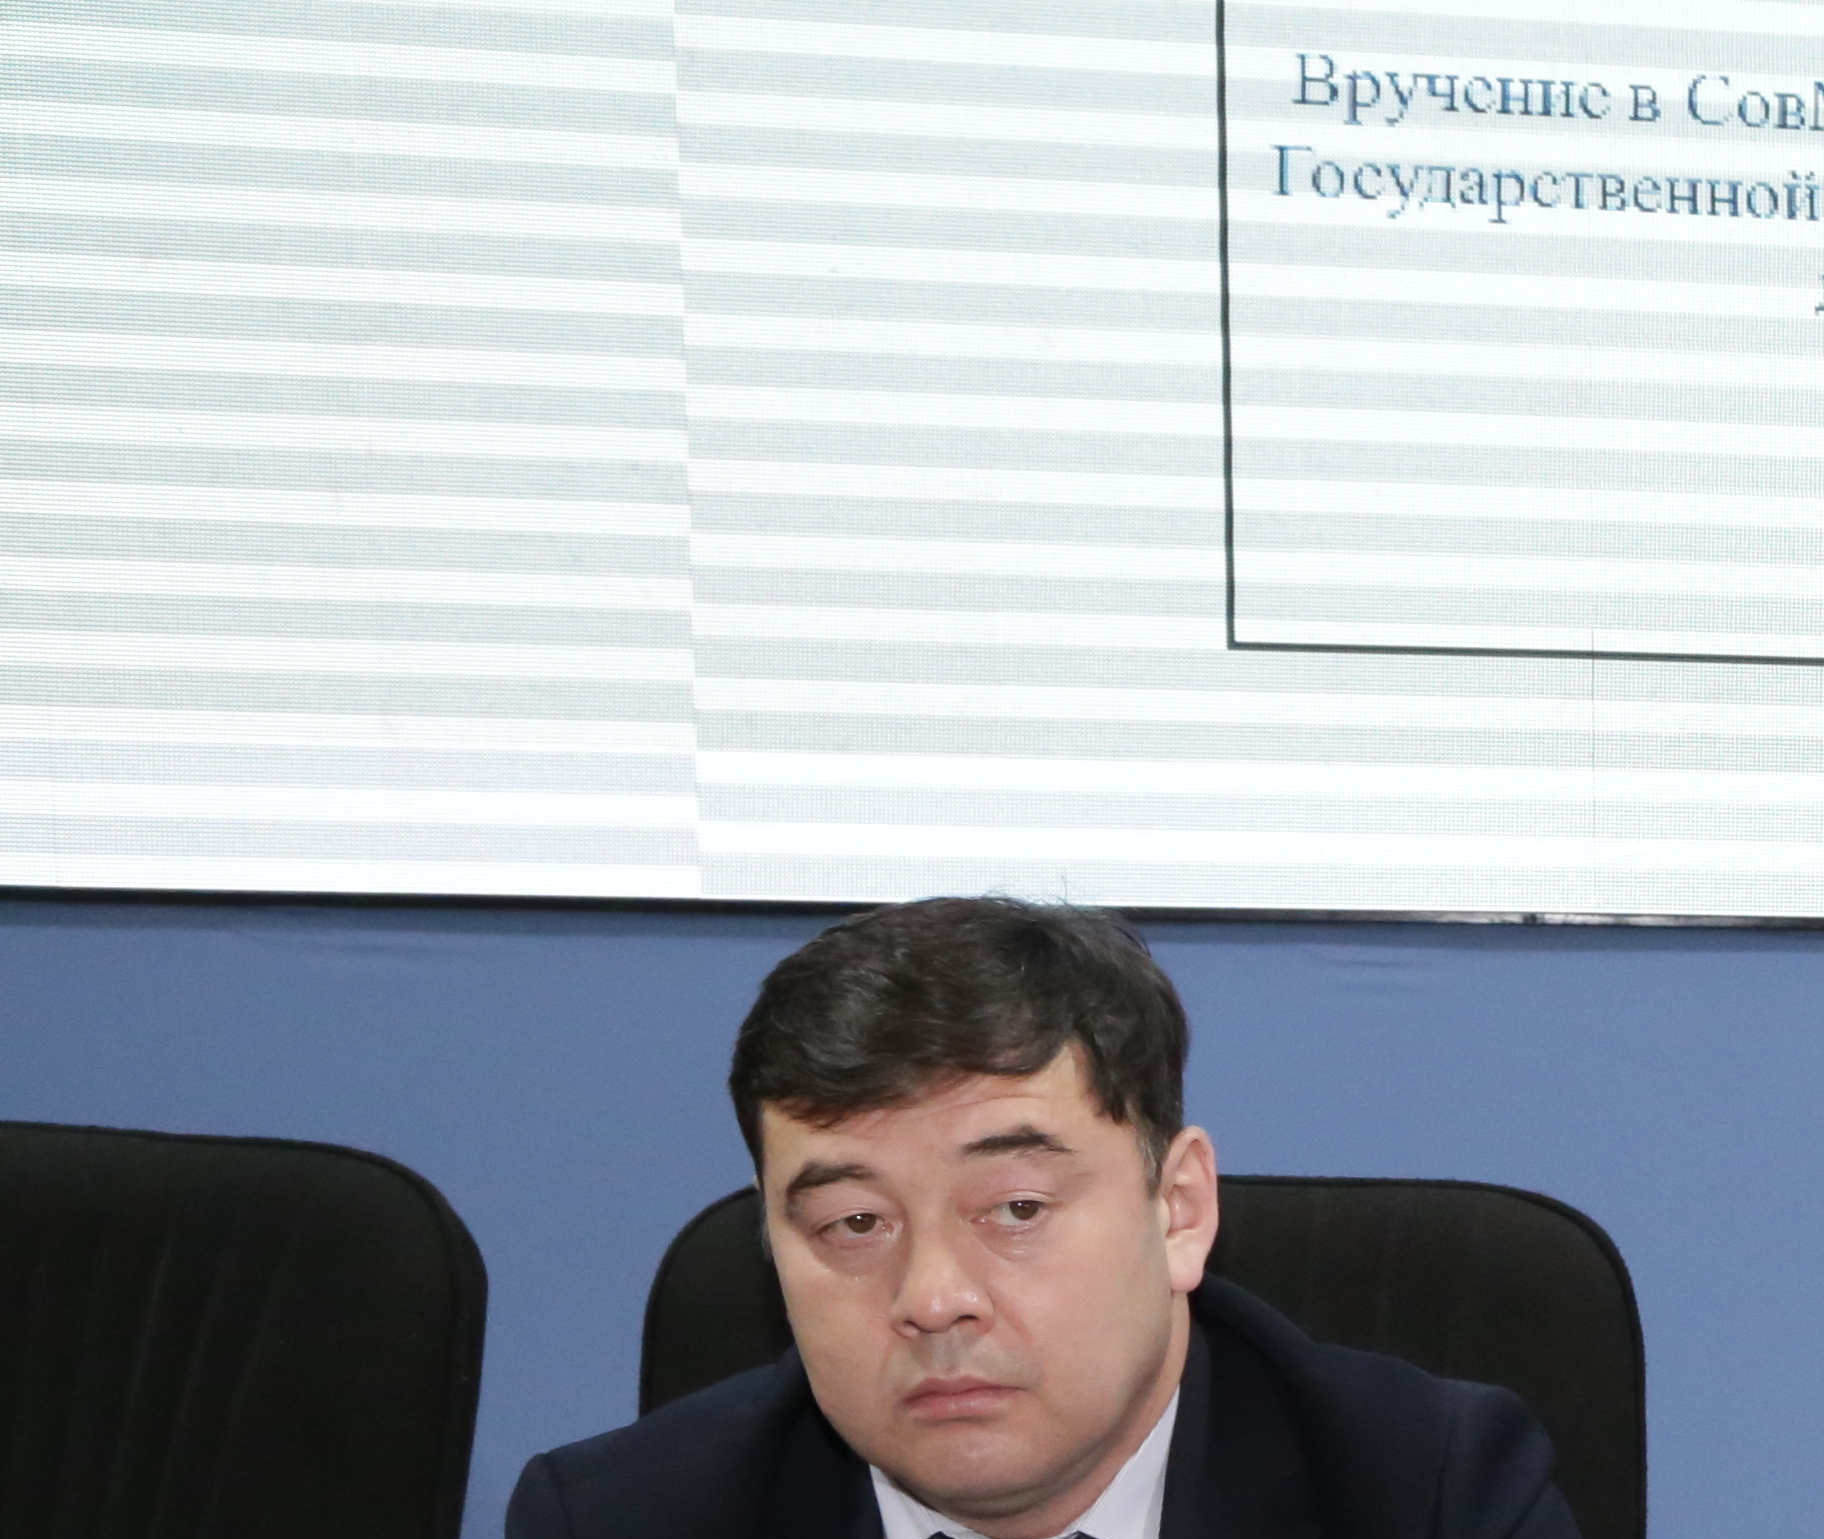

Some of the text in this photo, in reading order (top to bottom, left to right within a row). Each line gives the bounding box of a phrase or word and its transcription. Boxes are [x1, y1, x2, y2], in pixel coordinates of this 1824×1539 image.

[1292, 52, 1611, 126] Вручение
[1628, 83, 1661, 123] в
[1270, 144, 1820, 224] Государственной
